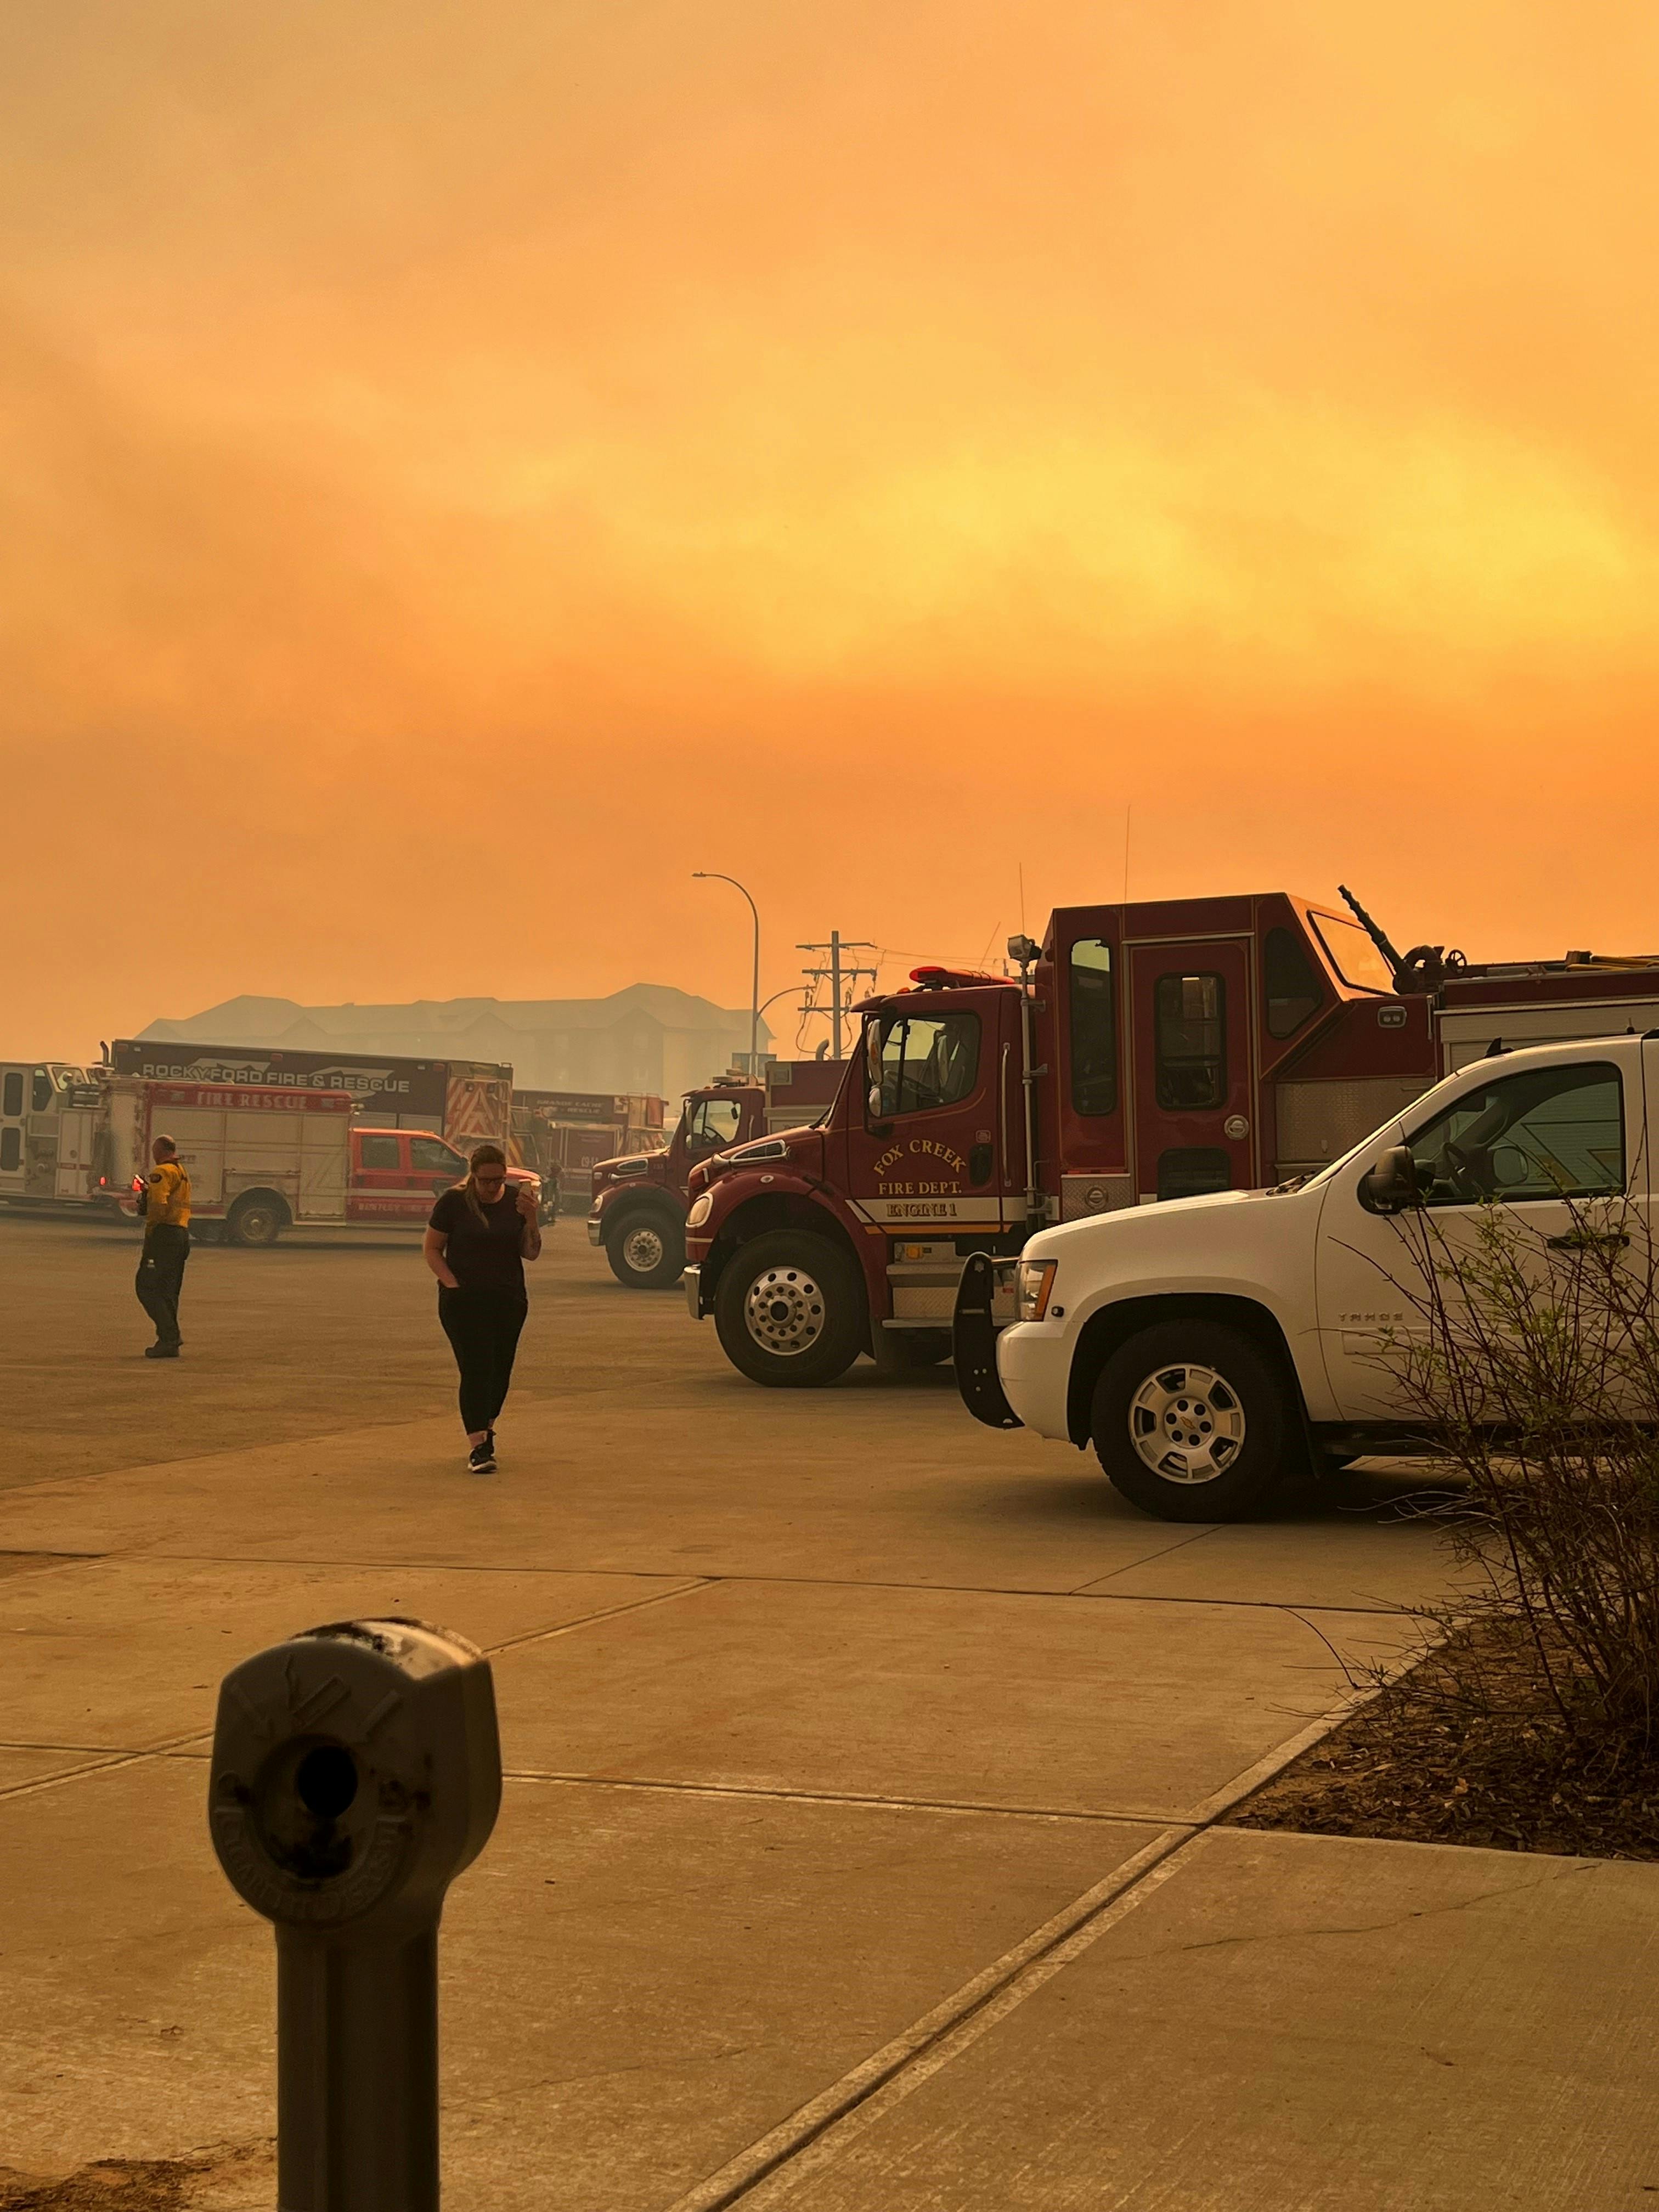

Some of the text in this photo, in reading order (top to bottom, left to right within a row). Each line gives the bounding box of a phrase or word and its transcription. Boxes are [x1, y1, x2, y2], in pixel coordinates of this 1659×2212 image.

[143, 1064, 410, 1093] ROCKYFORD FIRE & RESCUE
[197, 1091, 308, 1109] FIRE RESCUE
[873, 1139, 967, 1176] FOX CREEK
[879, 1181, 962, 1195] FIRE DEPT.
[886, 1203, 957, 1217] ENGINE 1
[1339, 1312, 1403, 1322] TAHOE
